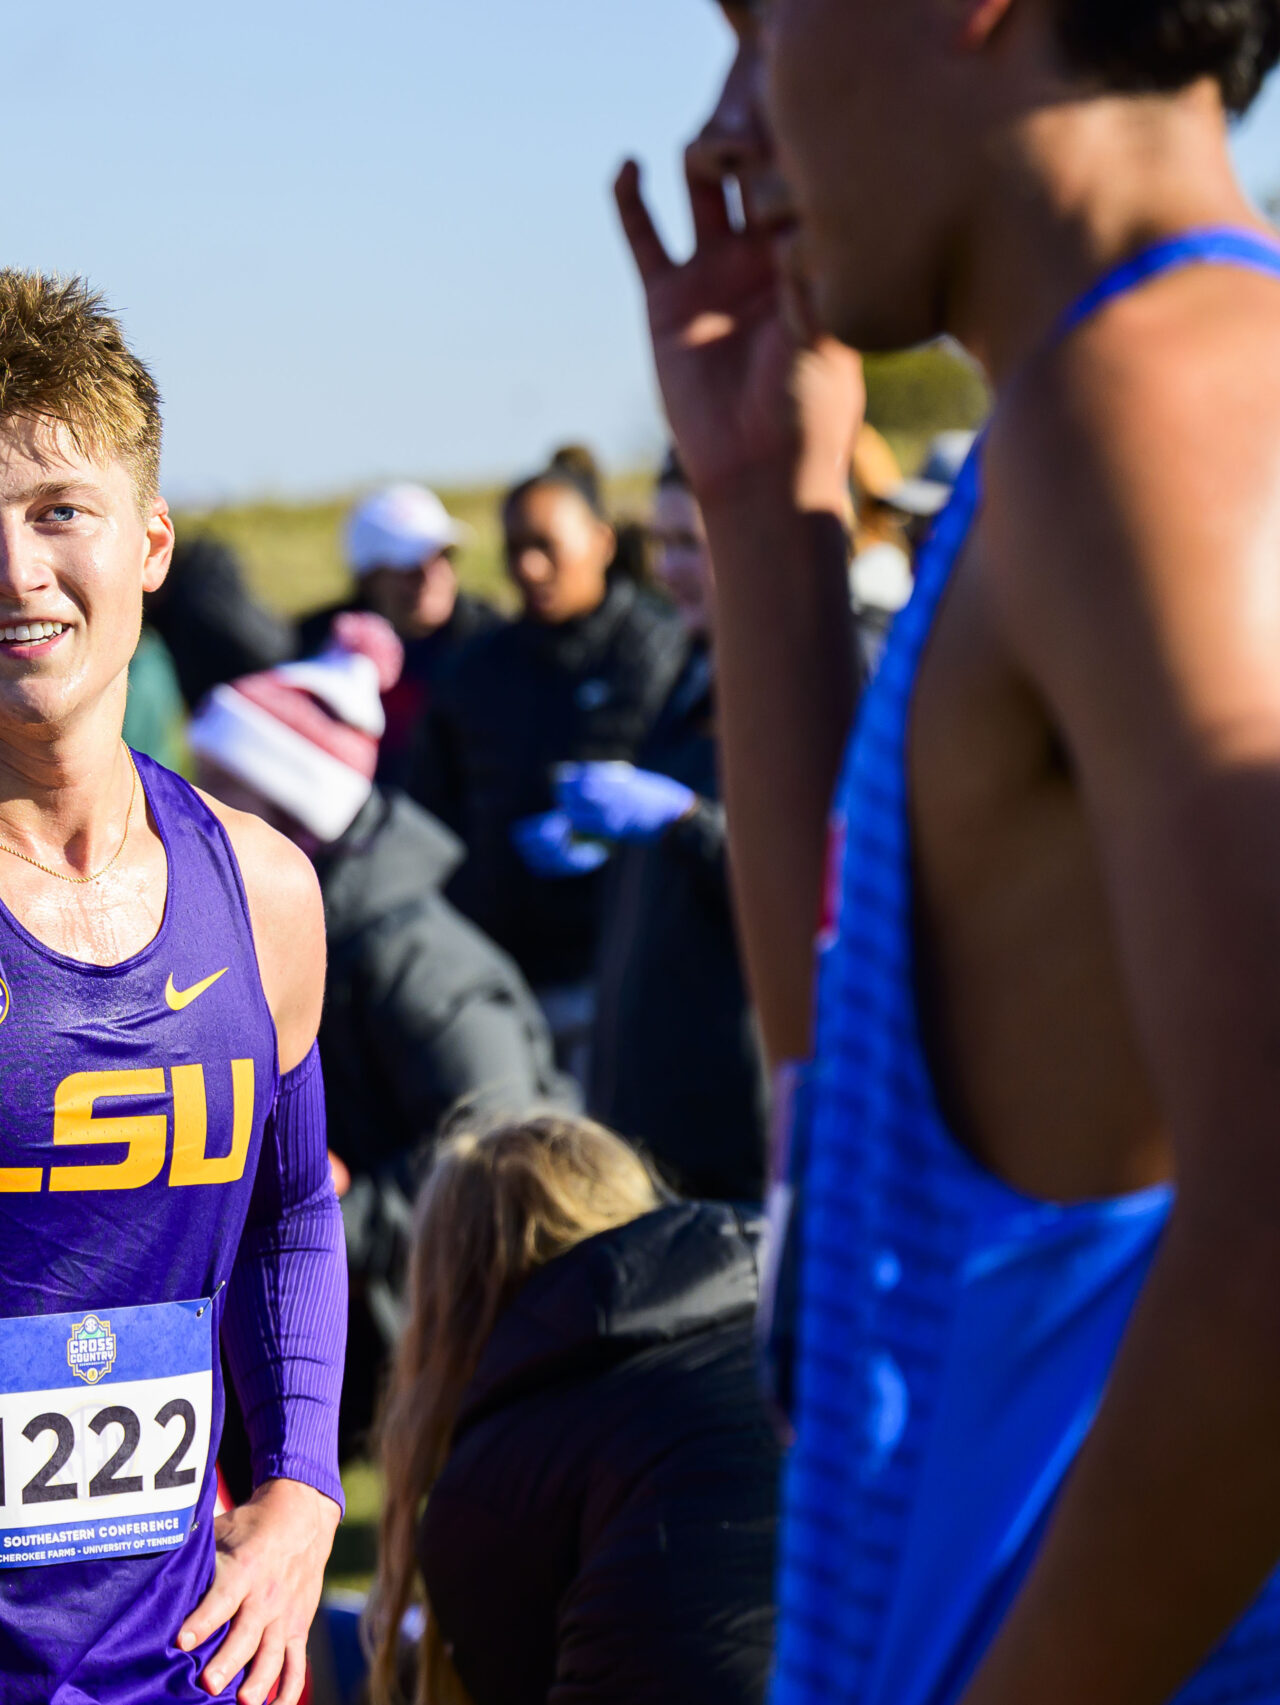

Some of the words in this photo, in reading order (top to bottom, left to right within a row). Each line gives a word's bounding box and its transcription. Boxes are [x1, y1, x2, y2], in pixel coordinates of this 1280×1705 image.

[70, 1337, 114, 1354] CROSS
[70, 1350, 114, 1364] COUNTRY
[3, 1528, 95, 1548] SOUTHEASTERN
[99, 1517, 179, 1538] CONFERENCE
[47, 1547, 76, 1559] FARMS
[82, 1541, 132, 1555] UNIVERSITY
[133, 1539, 145, 1549] OF
